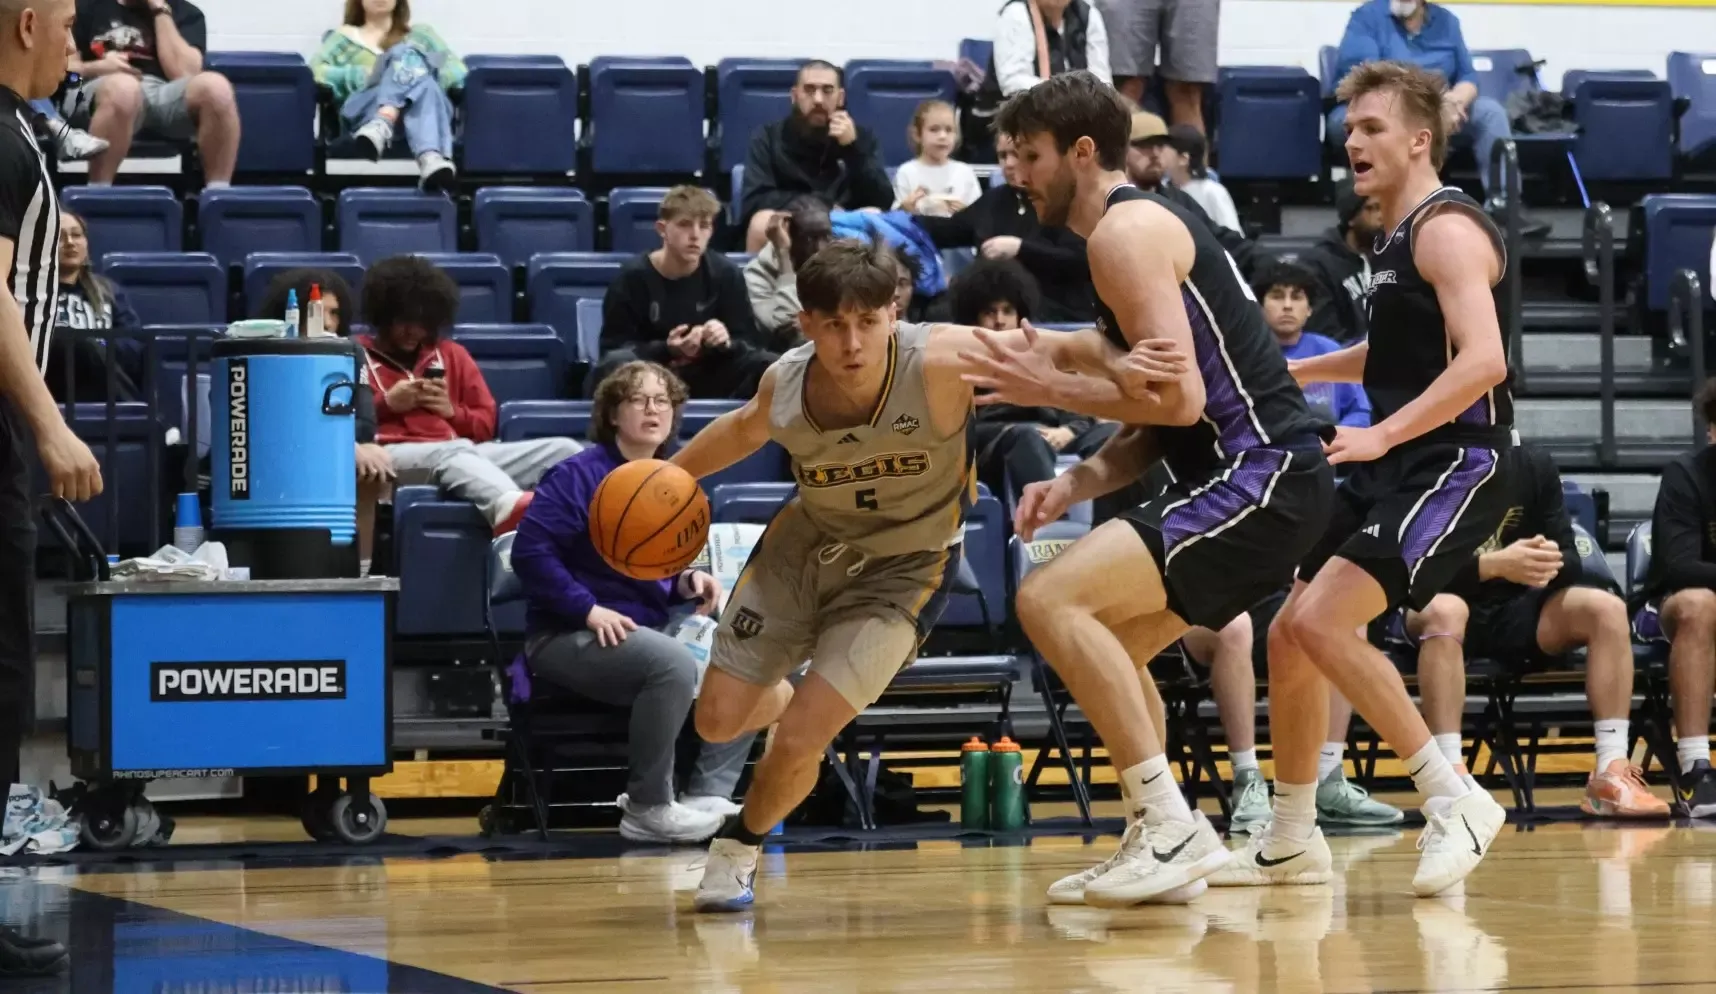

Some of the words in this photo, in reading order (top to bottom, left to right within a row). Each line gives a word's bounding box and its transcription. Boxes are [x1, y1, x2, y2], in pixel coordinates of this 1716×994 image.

[230, 366, 247, 492] POWERADE
[893, 418, 919, 431] RMAC
[855, 488, 878, 510] 5
[158, 667, 338, 695] POWERADE
